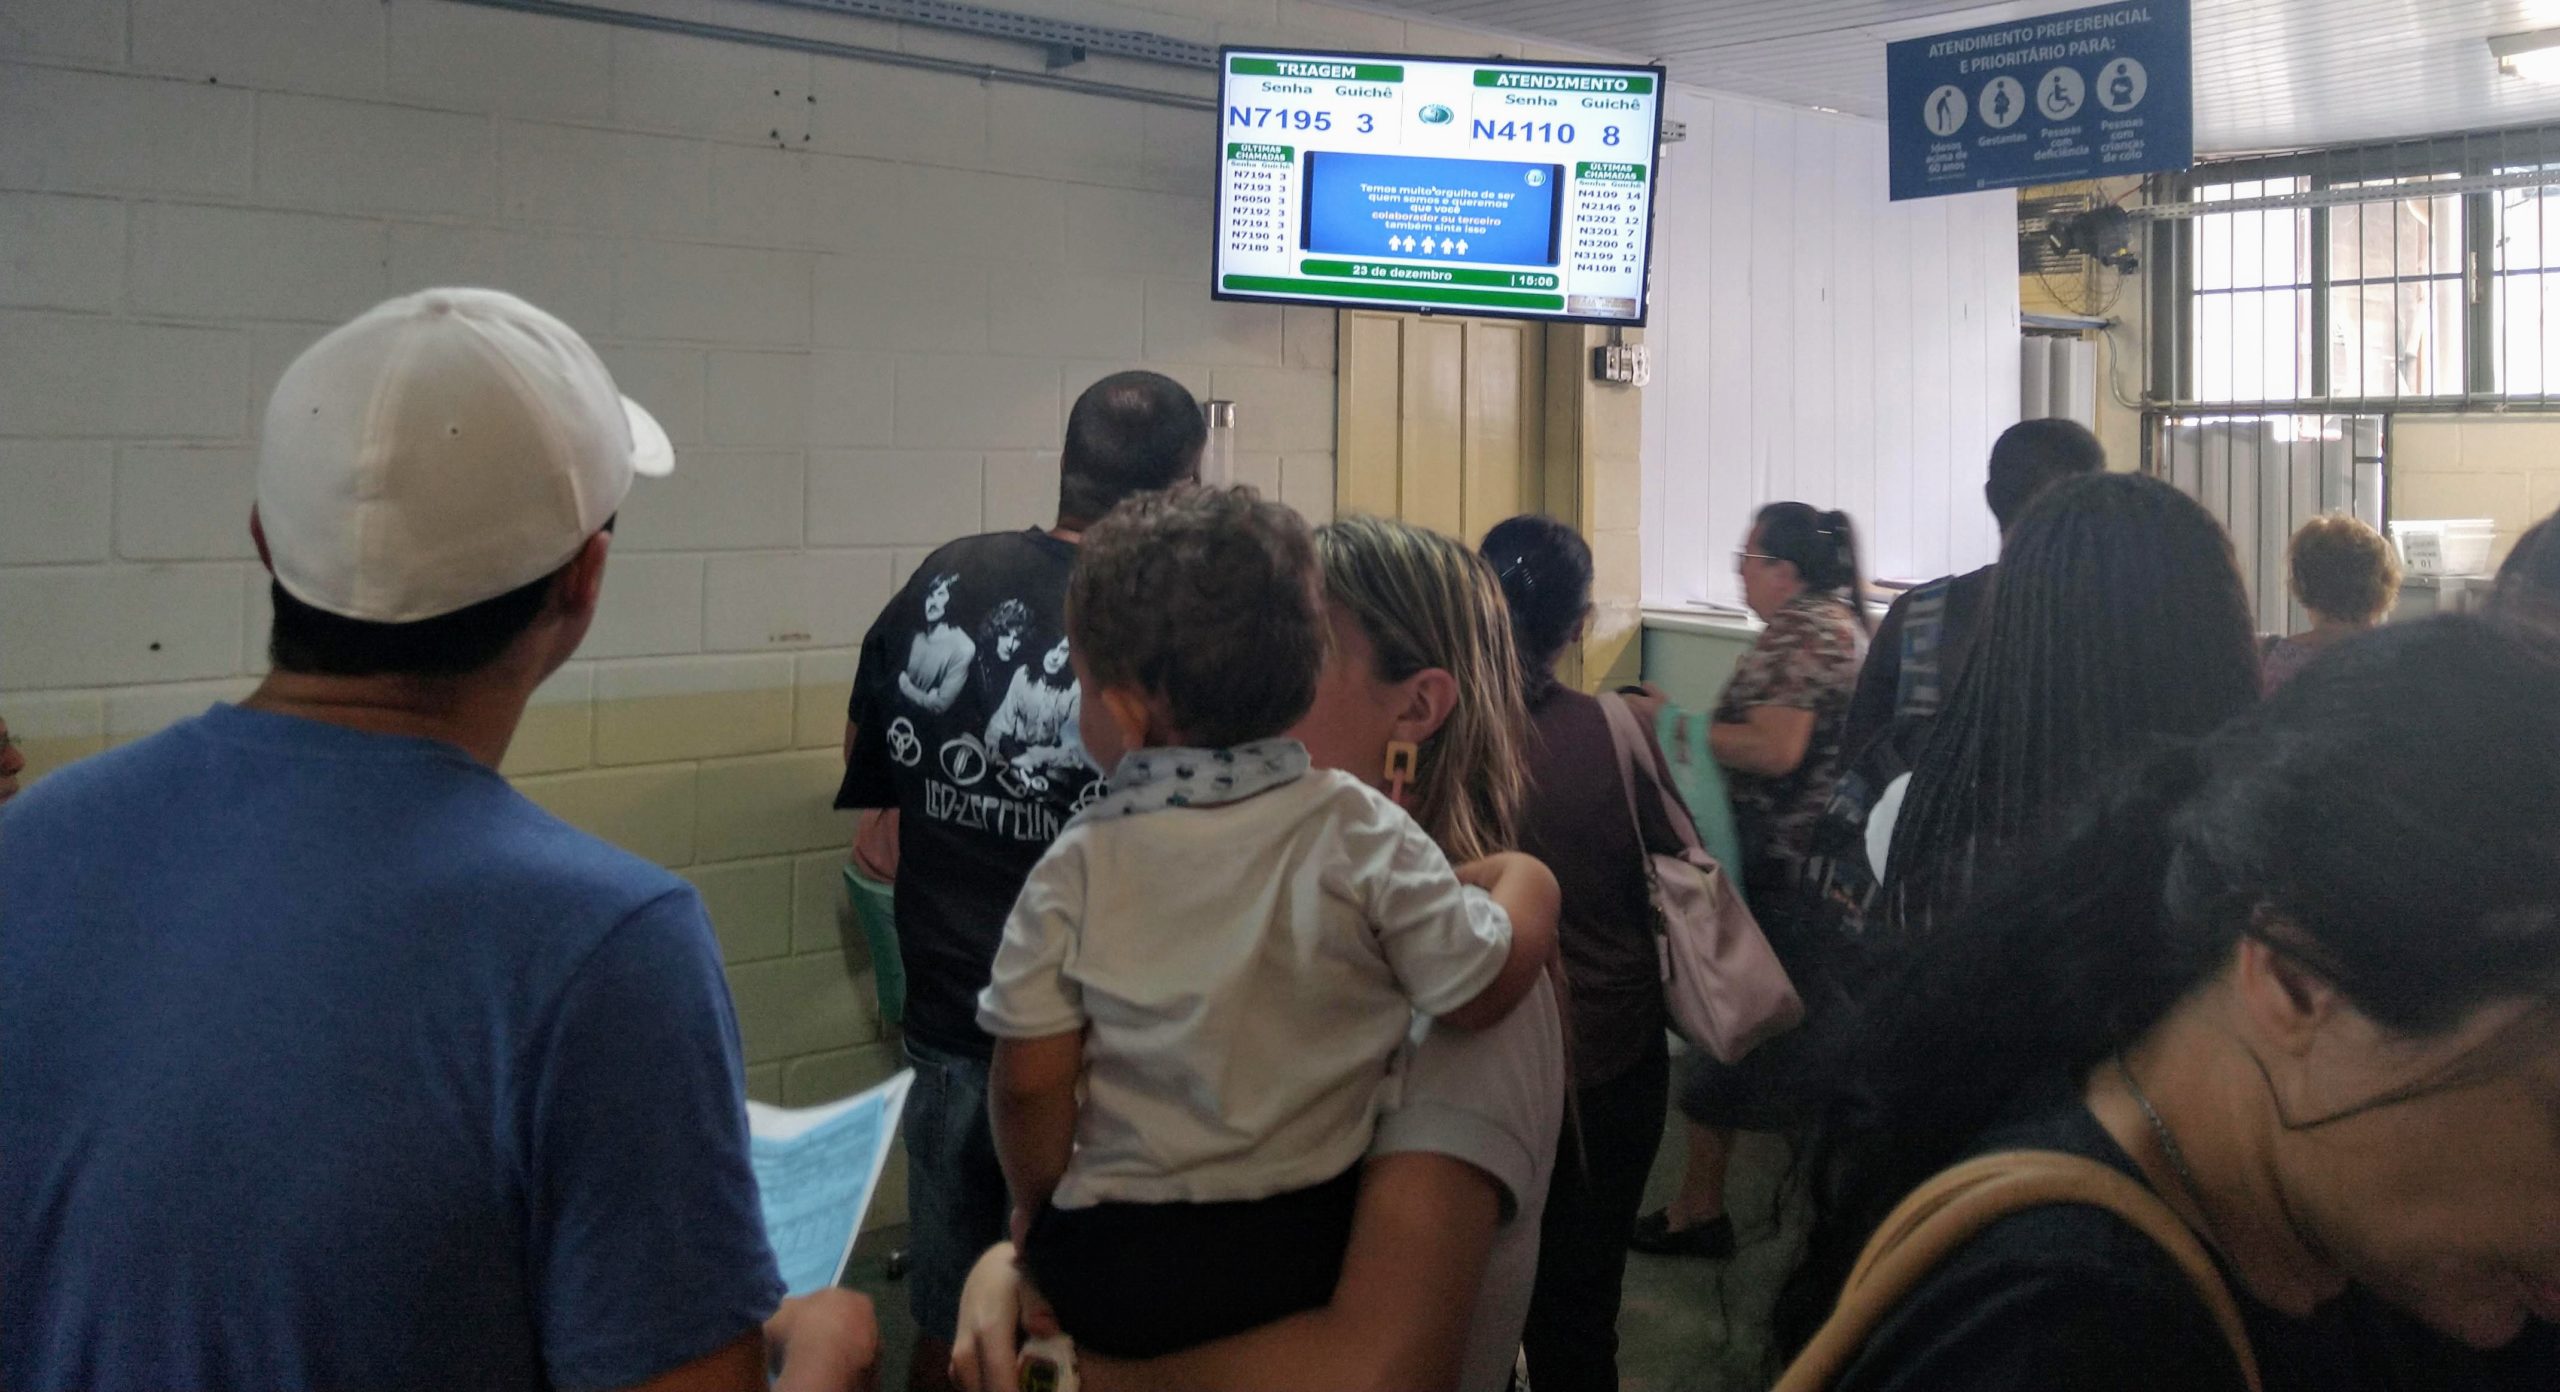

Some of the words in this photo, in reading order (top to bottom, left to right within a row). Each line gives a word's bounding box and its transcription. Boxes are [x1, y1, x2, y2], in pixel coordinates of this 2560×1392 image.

[1929, 27, 2033, 58] ATENDIMENTO
[2037, 7, 2151, 38] PREFERENCIAL
[1960, 60, 1969, 74] E
[1972, 44, 2066, 73] PRIORITÁRIO
[2069, 38, 2116, 57] PARA:
[1276, 63, 1357, 79] TRIAGEM
[1497, 73, 1629, 91] ATENDIMENTO
[1261, 81, 1313, 94] Senha
[1335, 85, 1393, 98] Guichê
[1505, 94, 1558, 107] Senha
[1581, 98, 1641, 111] Guichê
[1230, 106, 1332, 131] N7195
[1356, 113, 1374, 133] 3
[2101, 118, 2144, 130] Pessoas
[1472, 119, 1576, 144] N4110
[1602, 125, 1620, 146] 8
[2041, 125, 2082, 138] Pessoas
[2110, 130, 2134, 140] com
[1978, 133, 2028, 147] Gestantes
[2050, 138, 2073, 148] com
[2100, 139, 2145, 152] crianças
[1235, 151, 1286, 161] CHAMADAS
[1955, 150, 1968, 160] de
[2033, 145, 2090, 160] deficiência
[2103, 151, 2118, 163] de
[2119, 150, 2143, 161] colo
[1928, 163, 1941, 174] 60
[1941, 161, 1966, 171] anos
[1234, 170, 1272, 180] N7194
[1279, 173, 1286, 181] 3
[1584, 170, 1637, 180] CHAMADAS
[1233, 182, 1271, 192] N7193
[1279, 185, 1286, 193] 3
[1360, 183, 1397, 193] Temos
[1399, 185, 1432, 195] muito
[1434, 187, 1478, 199] orgulho
[1480, 190, 1495, 199] de
[1498, 192, 1516, 200] ser
[1234, 194, 1271, 204] P6050
[1278, 197, 1285, 205] 3
[1368, 193, 1401, 203] quem
[1403, 196, 1440, 205] somos
[1441, 197, 1450, 205] e
[1452, 198, 1509, 208] queremos
[1578, 190, 1618, 199] N4109
[1626, 192, 1641, 201] 14
[1232, 207, 1271, 217] N7192
[1278, 209, 1285, 217] 3
[1410, 204, 1432, 213] que
[1434, 204, 1461, 214] você
[1581, 202, 1621, 212] N2146
[1629, 204, 1636, 212] 9
[1232, 219, 1270, 228] N7191
[1277, 221, 1285, 229] 3
[1371, 211, 1438, 222] colaborador
[1458, 215, 1502, 226] terceiro
[1576, 214, 1616, 224] N3202
[1624, 217, 1639, 226] 12
[1385, 220, 1432, 231] também
[1434, 223, 1462, 232] sinta
[1465, 224, 1487, 234] isso
[1579, 227, 1619, 237] N3201
[1627, 229, 1635, 238] 7
[1231, 231, 1270, 240] N7190
[1276, 233, 1284, 241] 4
[1231, 243, 1269, 252] N7189
[1276, 245, 1284, 254] 3
[1578, 239, 1619, 249] N3200
[1626, 242, 1634, 250] 6
[1574, 251, 1614, 260] N3199
[1622, 254, 1637, 262] 12
[1577, 264, 1617, 273] N4108
[1352, 264, 1368, 276] 23
[1371, 266, 1387, 277] de
[1389, 267, 1453, 281] dezembro
[1519, 275, 1553, 287] 15:06
